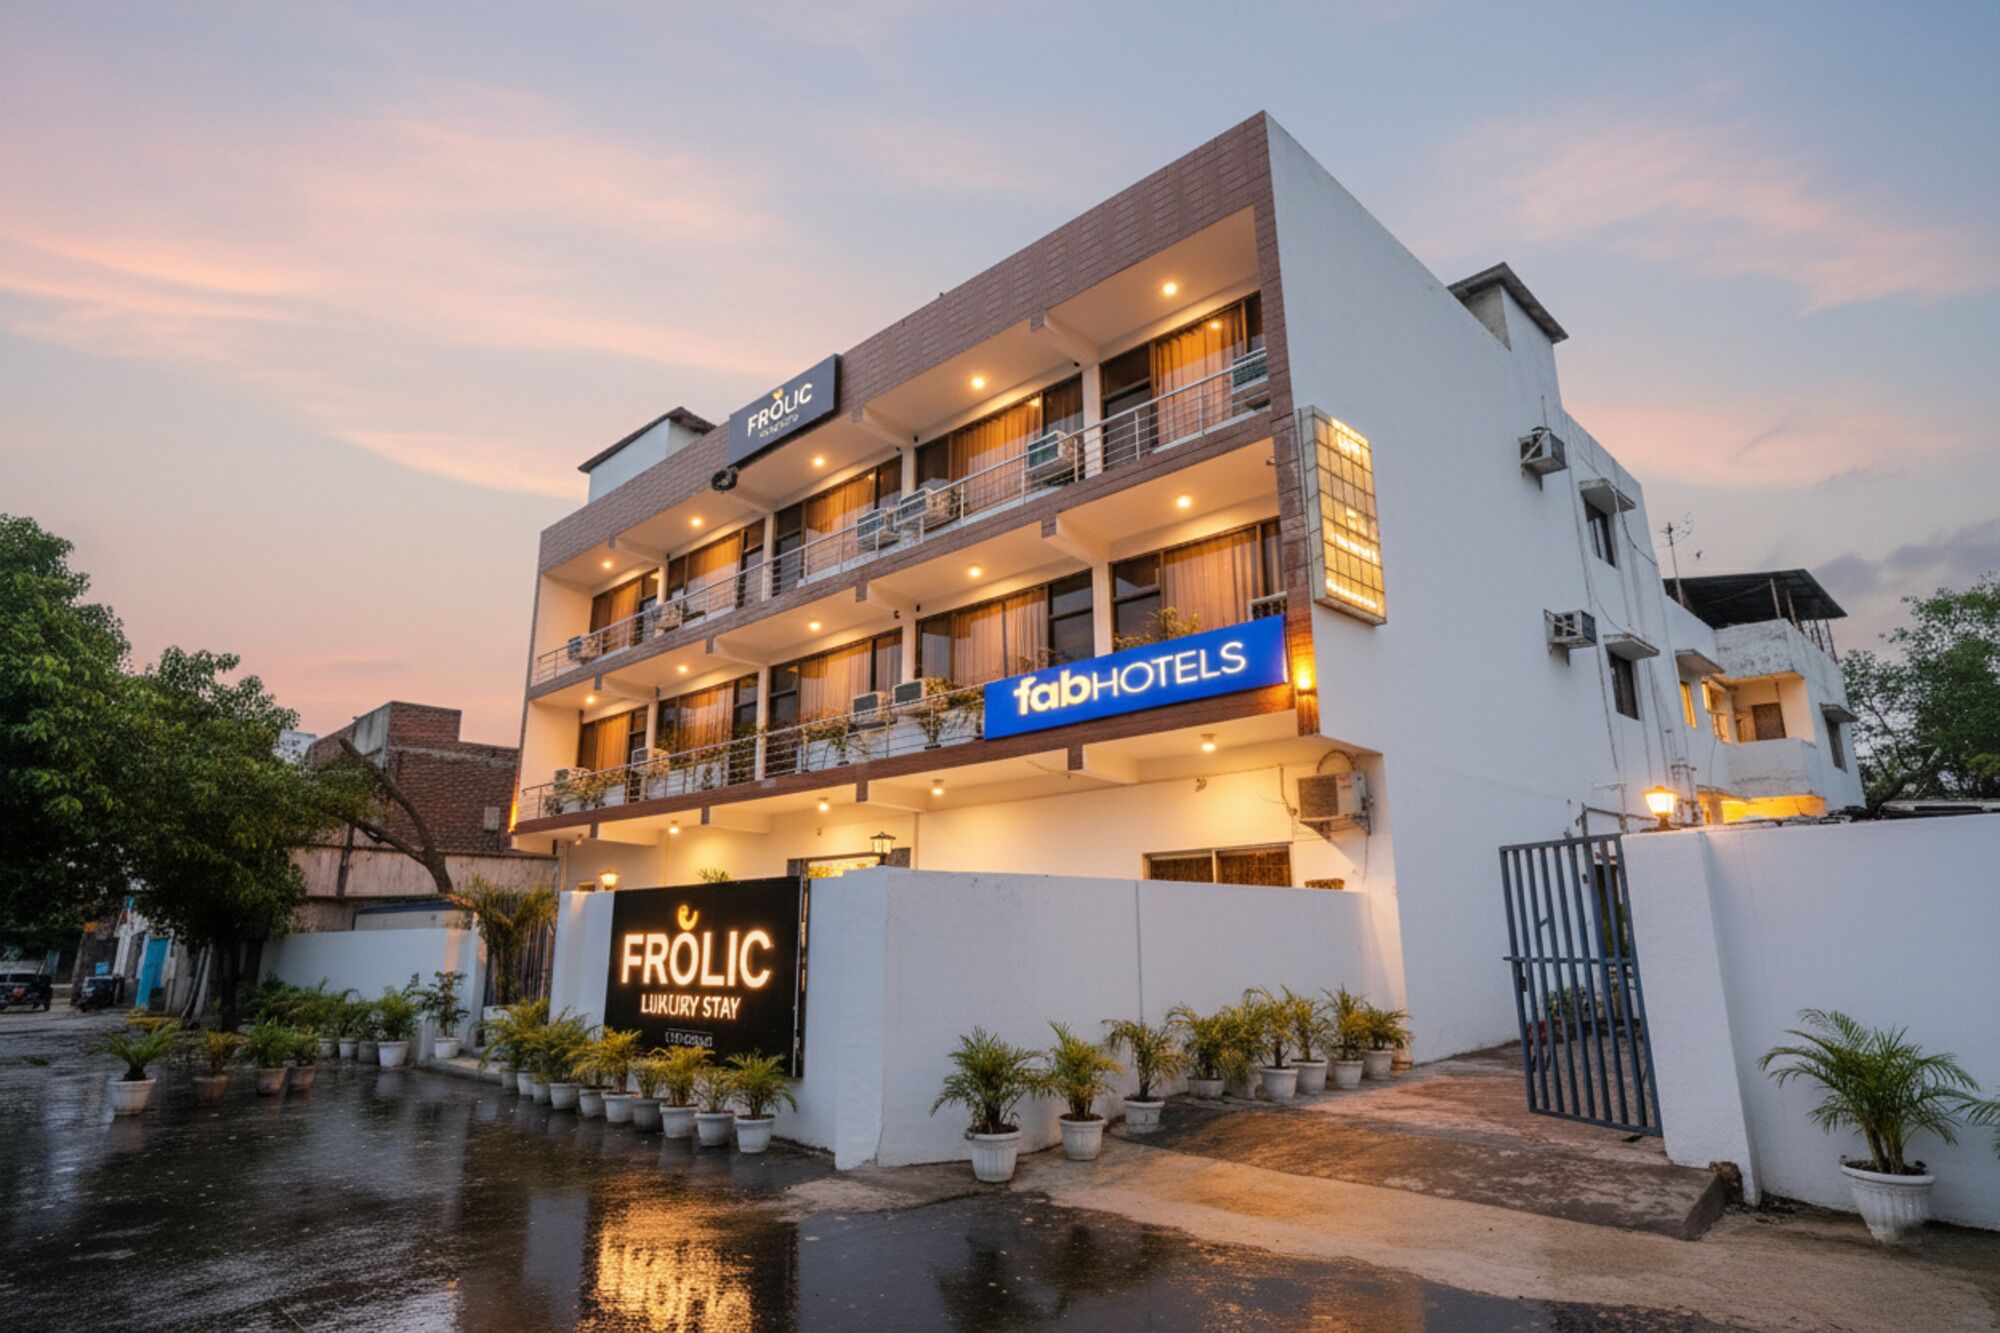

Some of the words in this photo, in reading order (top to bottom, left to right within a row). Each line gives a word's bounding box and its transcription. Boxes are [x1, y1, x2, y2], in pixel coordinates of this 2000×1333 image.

[748, 383, 813, 437] FROLIC
[1013, 641, 1247, 715] fabHOTELS
[621, 930, 772, 988] FROLIC
[702, 996, 741, 1019] STAY
